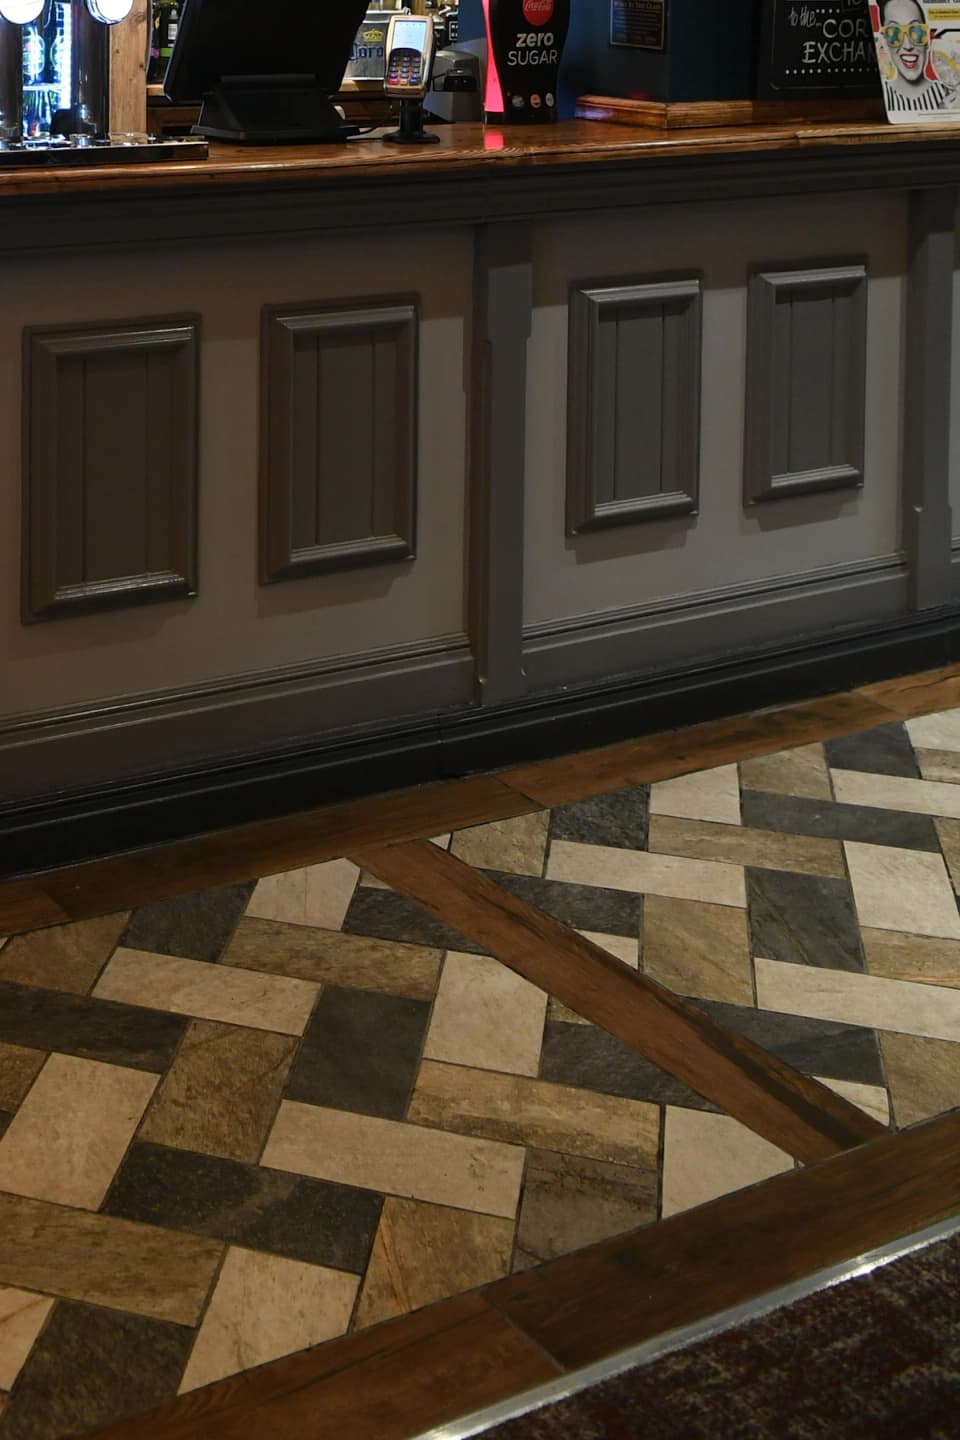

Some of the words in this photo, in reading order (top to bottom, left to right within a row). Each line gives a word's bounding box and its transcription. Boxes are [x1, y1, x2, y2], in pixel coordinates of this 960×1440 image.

[524, 0, 553, 12] Coca-Cola
[788, 7, 799, 27] to
[822, 18, 869, 38] COR
[515, 32, 554, 48] zero
[506, 49, 558, 66] SUGAR
